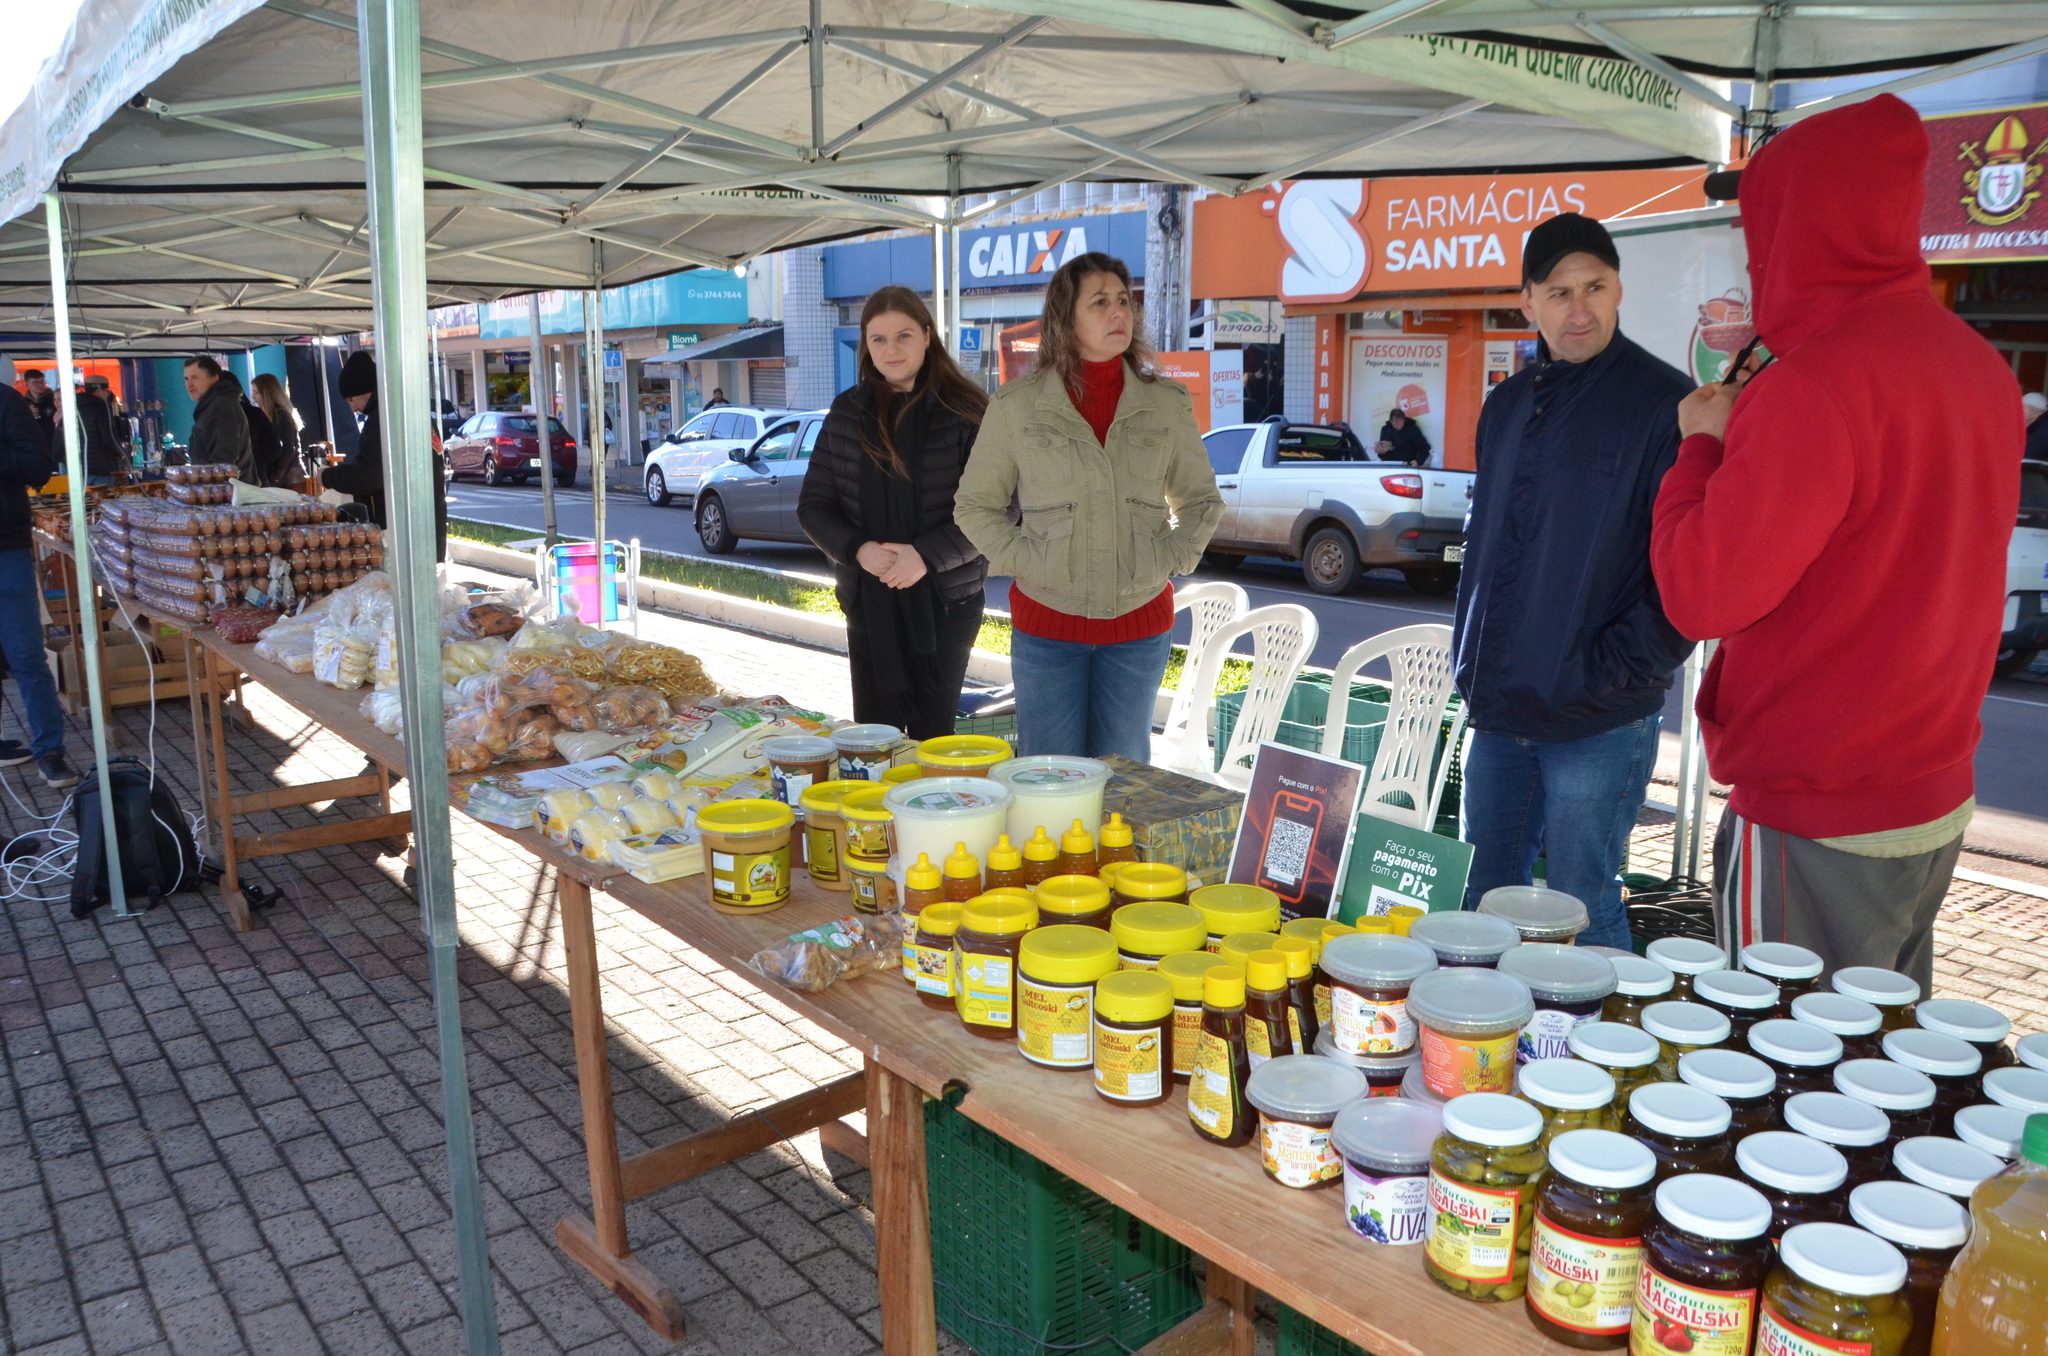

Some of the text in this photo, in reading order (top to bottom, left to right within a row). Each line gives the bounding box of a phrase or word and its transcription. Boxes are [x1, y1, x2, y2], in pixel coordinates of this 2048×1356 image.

[1587, 57, 1682, 111] CONSOME!
[1387, 181, 1586, 232] FARMÁCIAS
[968, 226, 1088, 278] CAIXA
[1385, 232, 1506, 272] SANTA
[1364, 344, 1443, 359] DESCONTOS
[1213, 369, 1241, 383] OFERTAS
[1278, 775, 1297, 787] Pague
[1296, 782, 1309, 791] com
[1372, 850, 1438, 877] pagamento
[1385, 839, 1435, 863] Faça o seu
[1370, 864, 1435, 900] com o Pix
[1024, 988, 1048, 1003] MEL
[1177, 1014, 1199, 1022] MEL
[1103, 1033, 1122, 1045] MEL
[1537, 1037, 1569, 1059] UVA
[1429, 1181, 1487, 1221] AGALSKI
[1389, 1211, 1427, 1242] UVA
[1533, 1223, 1599, 1282] MAGALSKI
[1540, 1234, 1588, 1266] Produtos
[1639, 1262, 1740, 1328] MAGALSKI
[1653, 1278, 1725, 1312] Produtos
